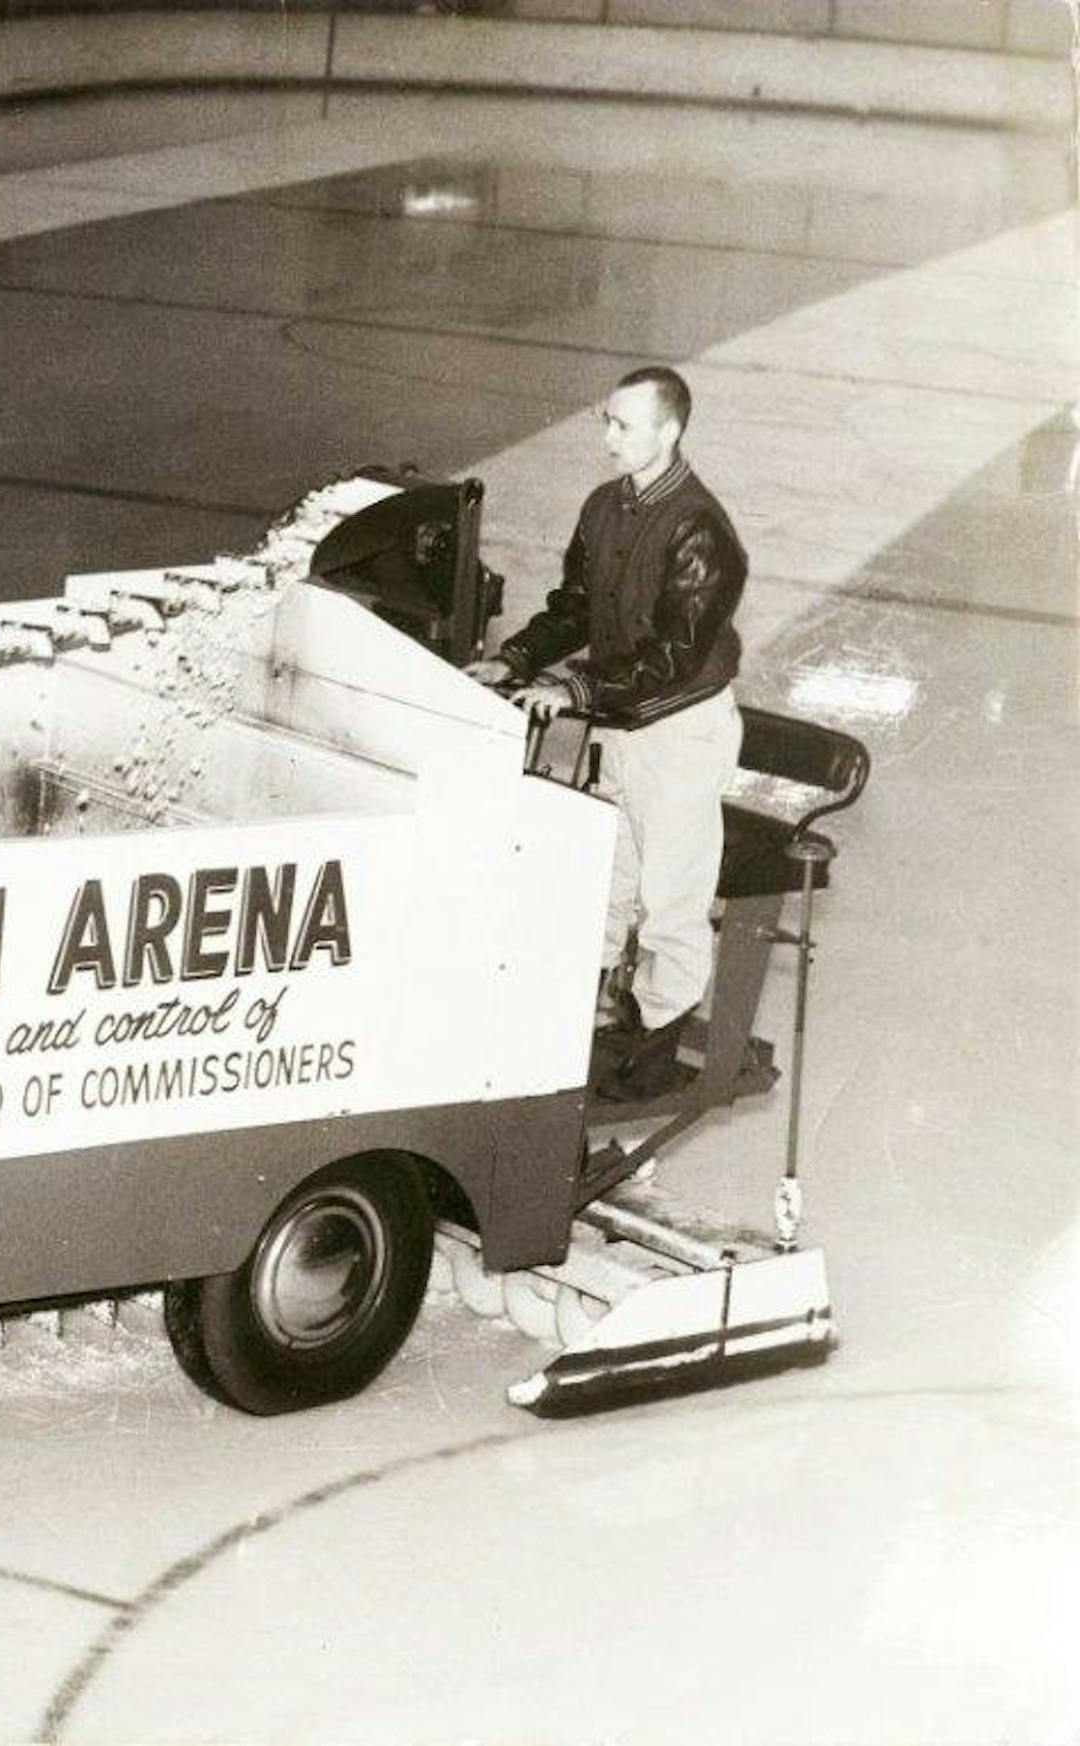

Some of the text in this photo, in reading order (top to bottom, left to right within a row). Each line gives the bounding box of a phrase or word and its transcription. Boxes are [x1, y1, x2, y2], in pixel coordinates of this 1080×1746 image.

[46, 860, 352, 995] ARENA
[6, 1009, 86, 1055] and
[95, 988, 240, 1046] control
[245, 986, 287, 1044] of
[23, 1073, 62, 1117] OF
[82, 1041, 355, 1109] COMMISSIONERS
